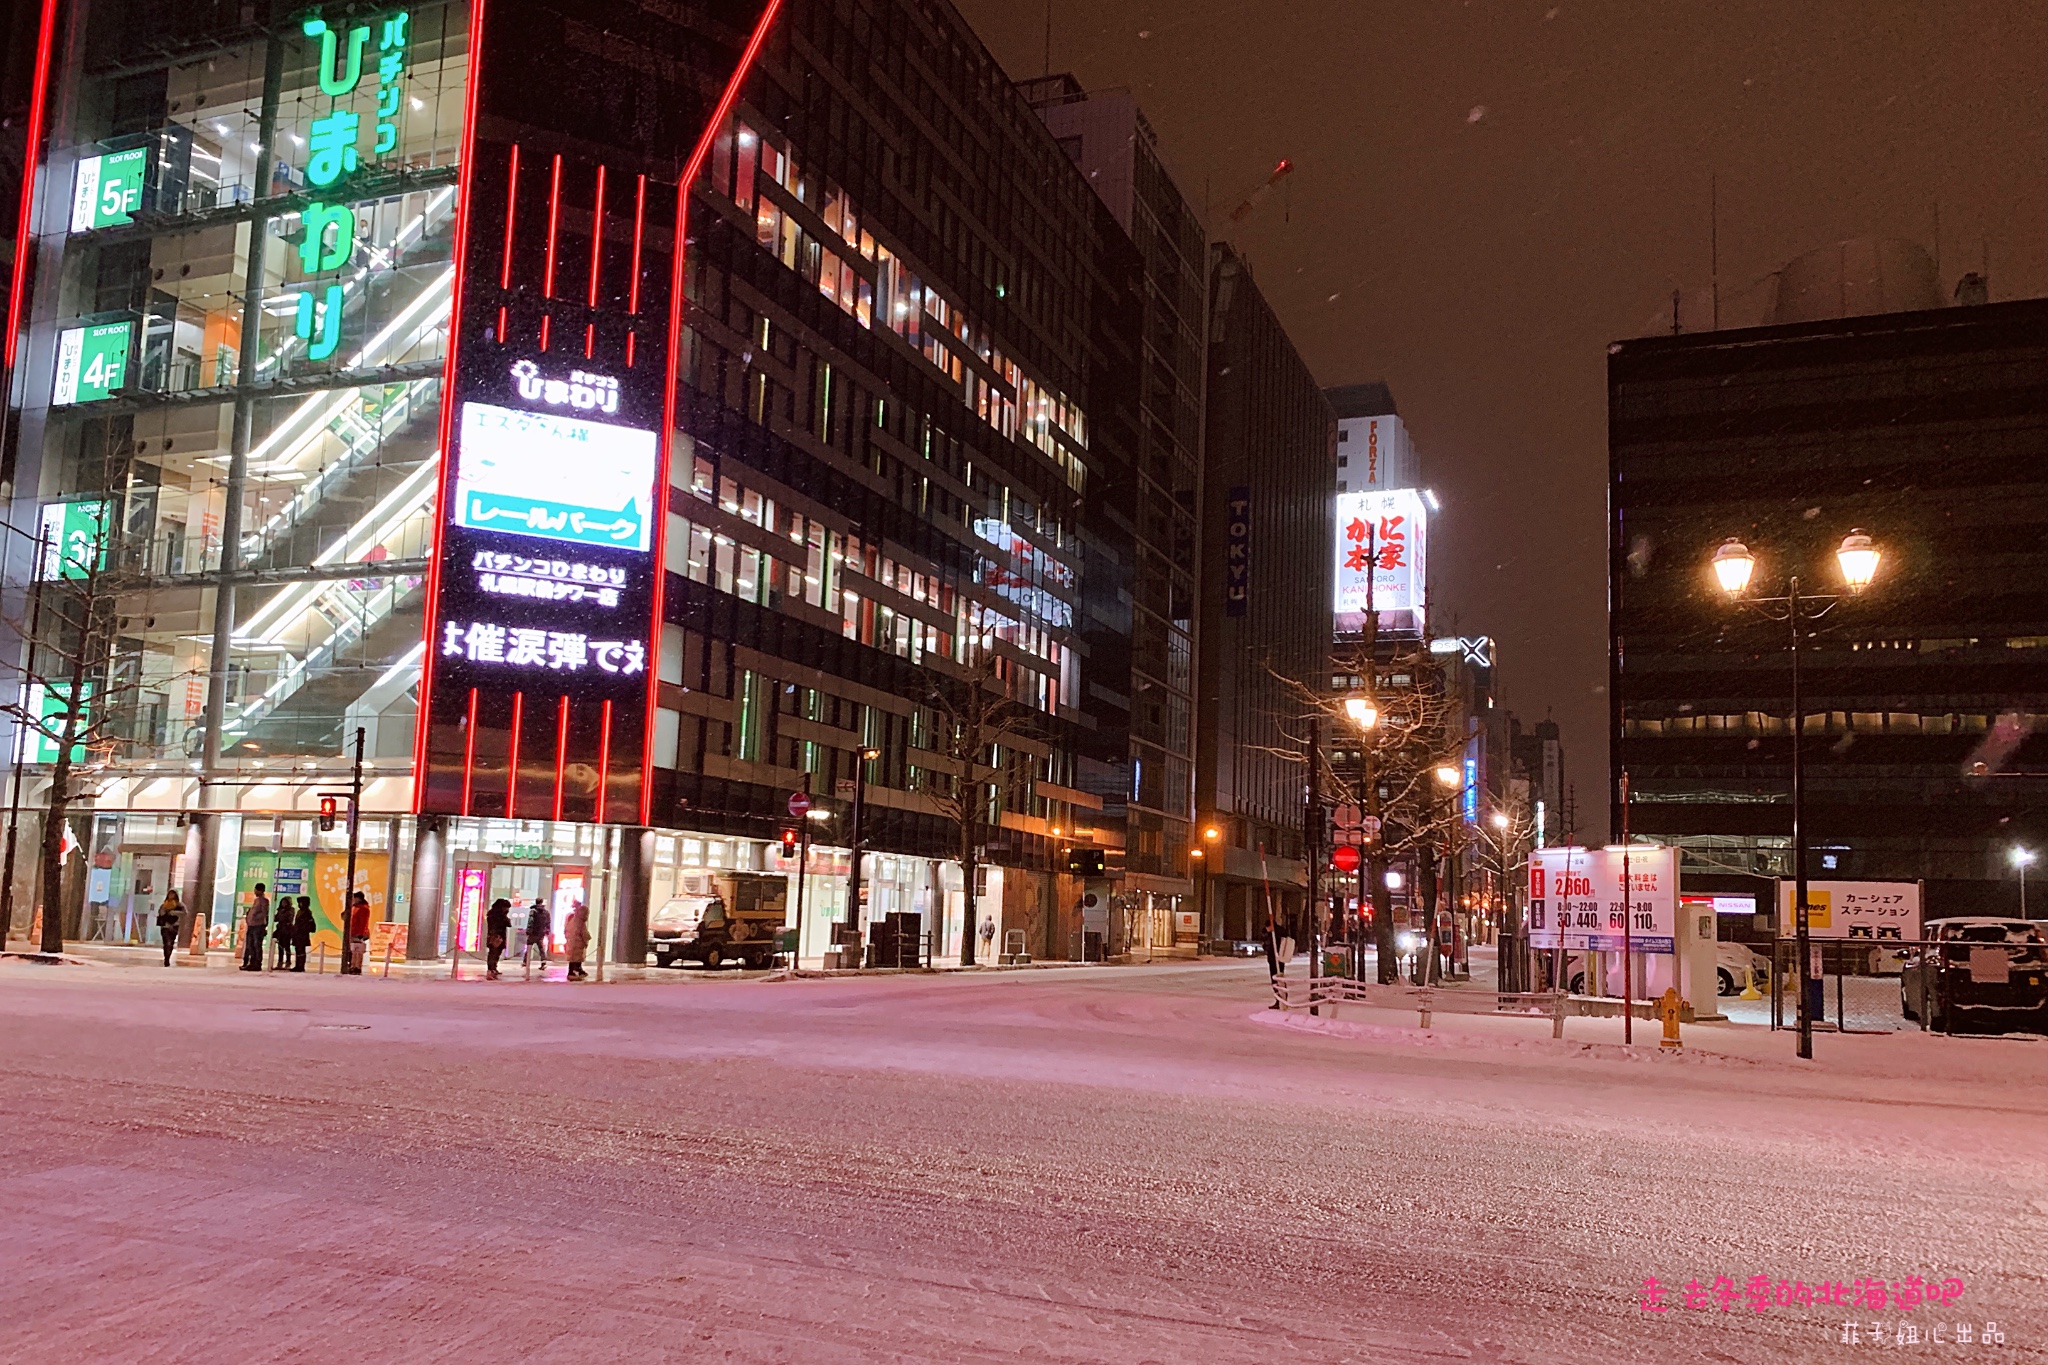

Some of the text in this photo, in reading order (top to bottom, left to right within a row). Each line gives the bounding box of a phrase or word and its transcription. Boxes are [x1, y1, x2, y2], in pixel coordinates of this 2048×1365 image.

[374, 12, 409, 154] パチンコ
[109, 155, 124, 164] SLOT
[101, 178, 138, 216] 5F
[296, 19, 371, 361] ひまわり
[93, 328, 107, 337] SLOT
[82, 352, 121, 389] 4F
[510, 360, 618, 413] ひまわり
[1368, 420, 1377, 483] FORZA
[471, 551, 626, 584] パチンコひまわり
[1229, 500, 1247, 600] TOKYU
[1354, 575, 1396, 584] SAPORO
[1840, 905, 1911, 918] ステーション
[1845, 894, 1904, 904] カーシェア
